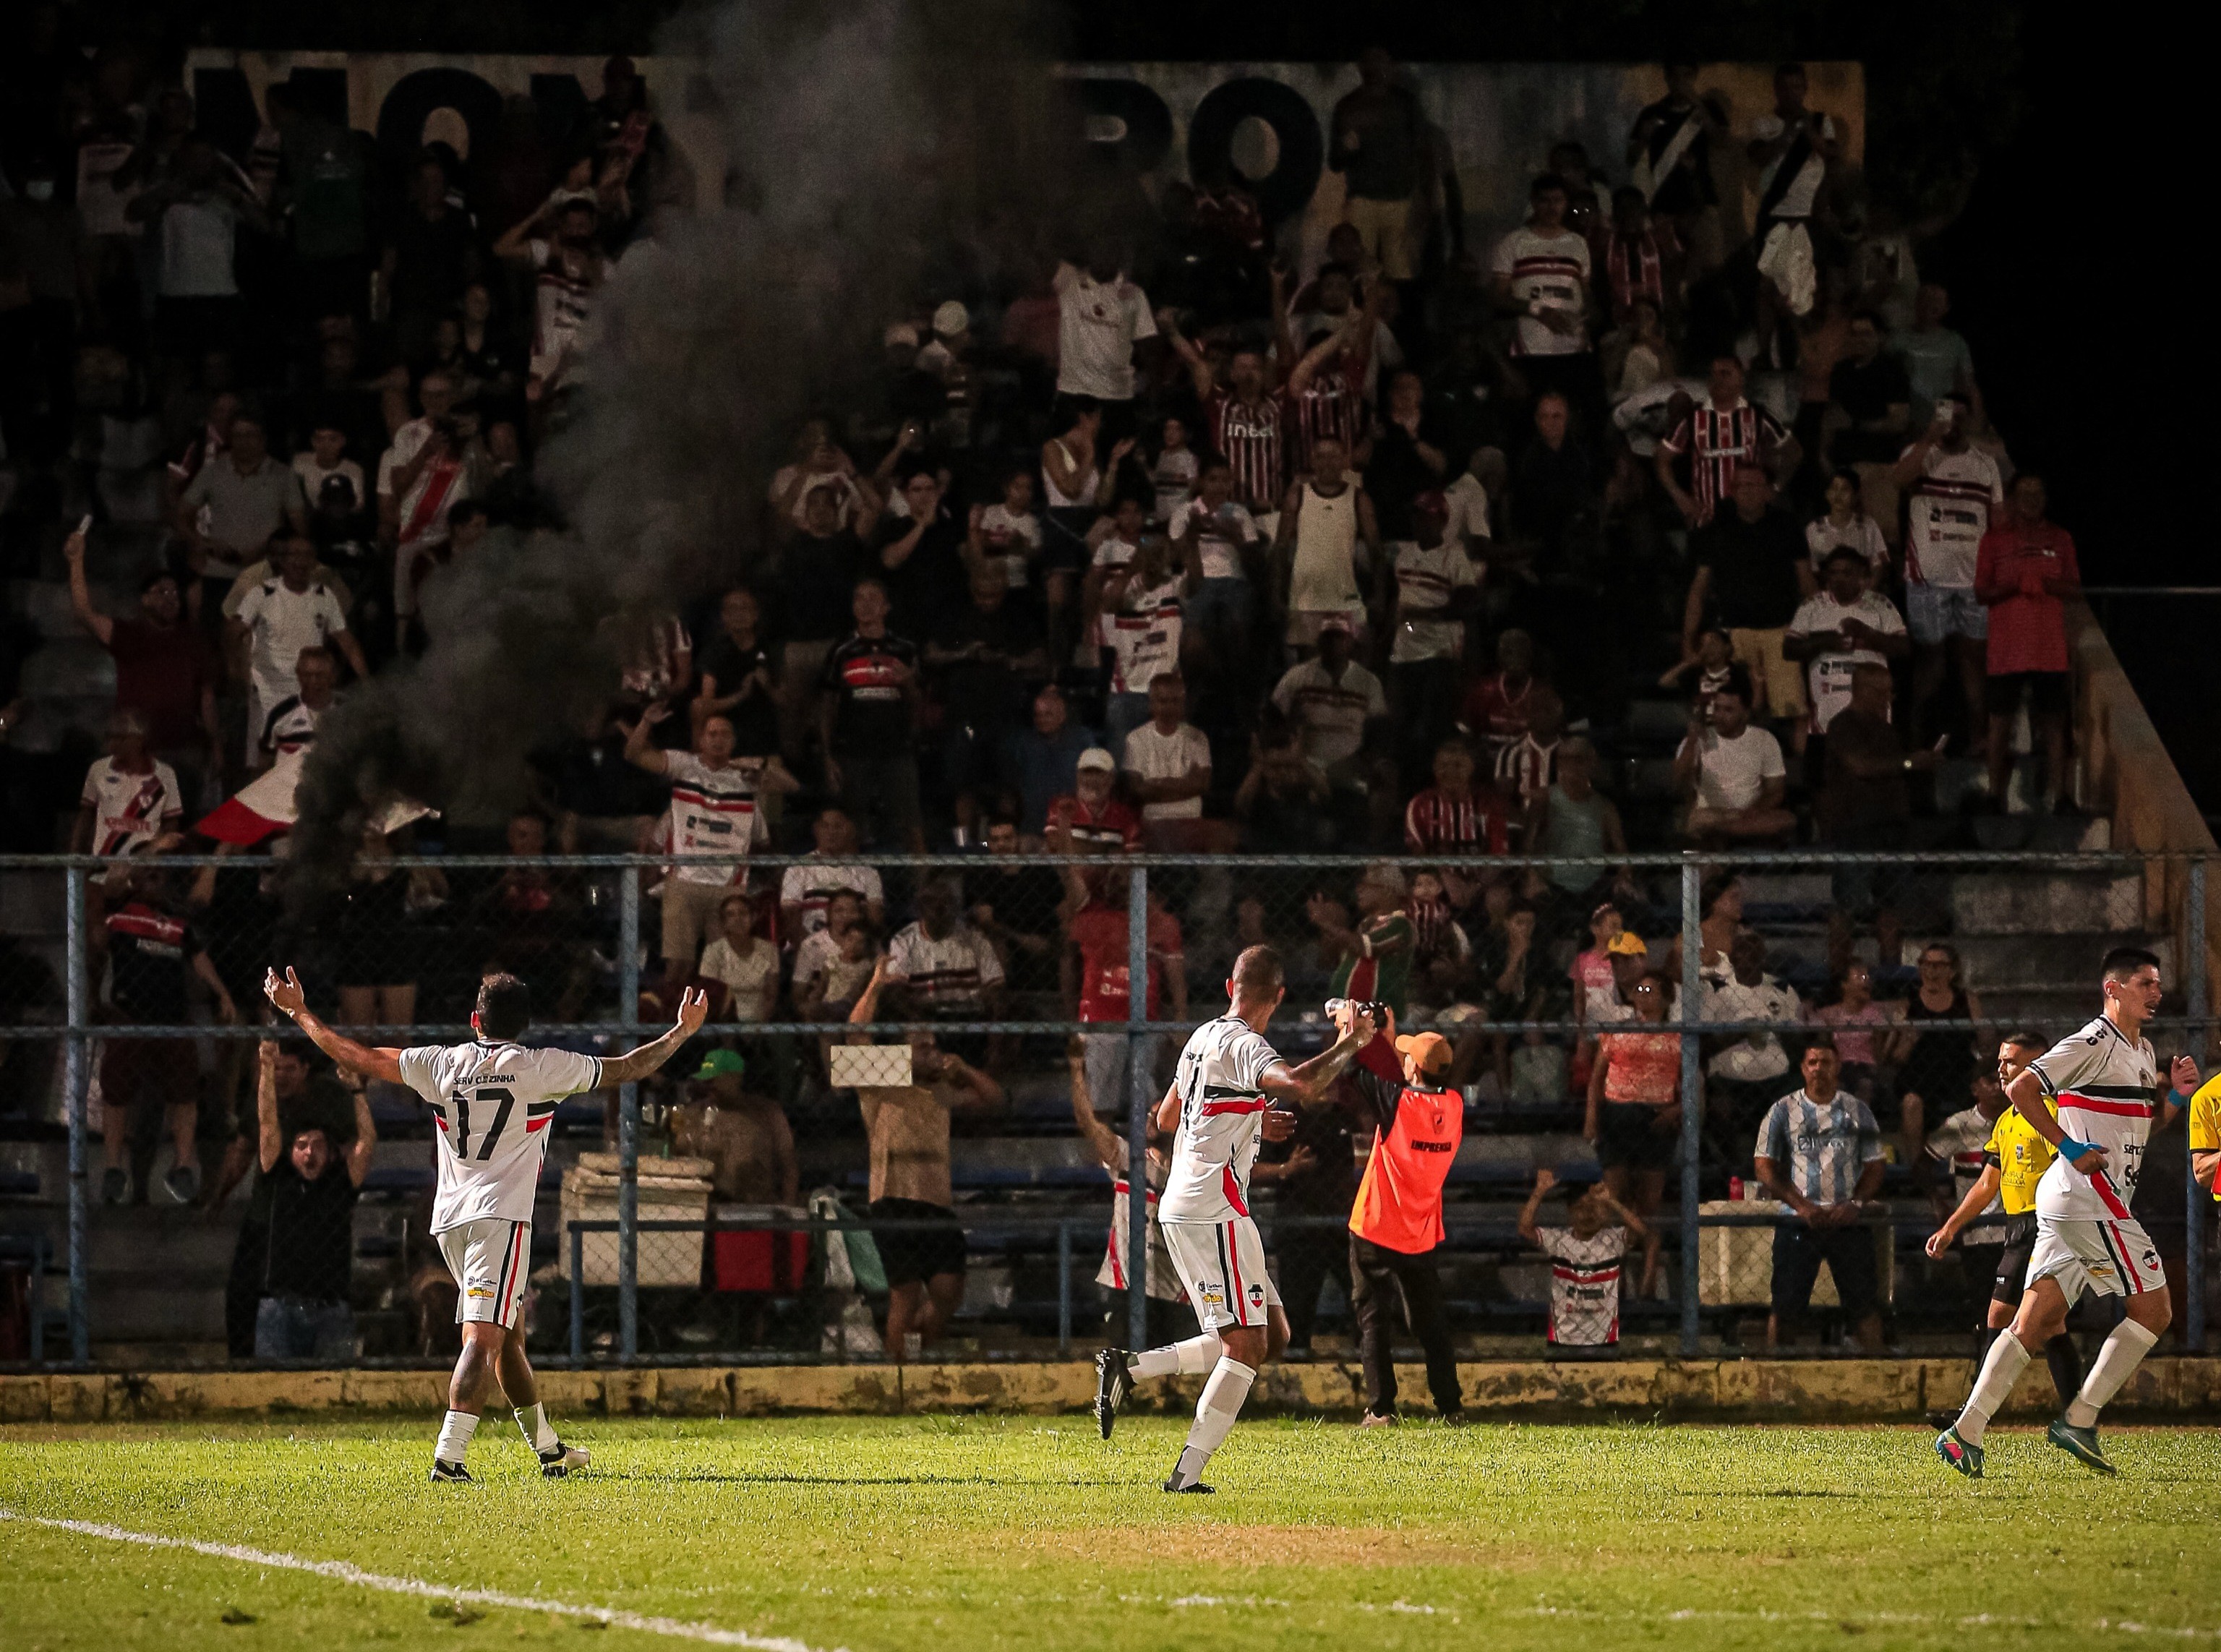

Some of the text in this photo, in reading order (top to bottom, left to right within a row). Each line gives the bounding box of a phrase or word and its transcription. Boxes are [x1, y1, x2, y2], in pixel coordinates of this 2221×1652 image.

[453, 1076, 474, 1085] SERV
[452, 1087, 515, 1161] 17
[1411, 1139, 1452, 1153] IMPRENSA
